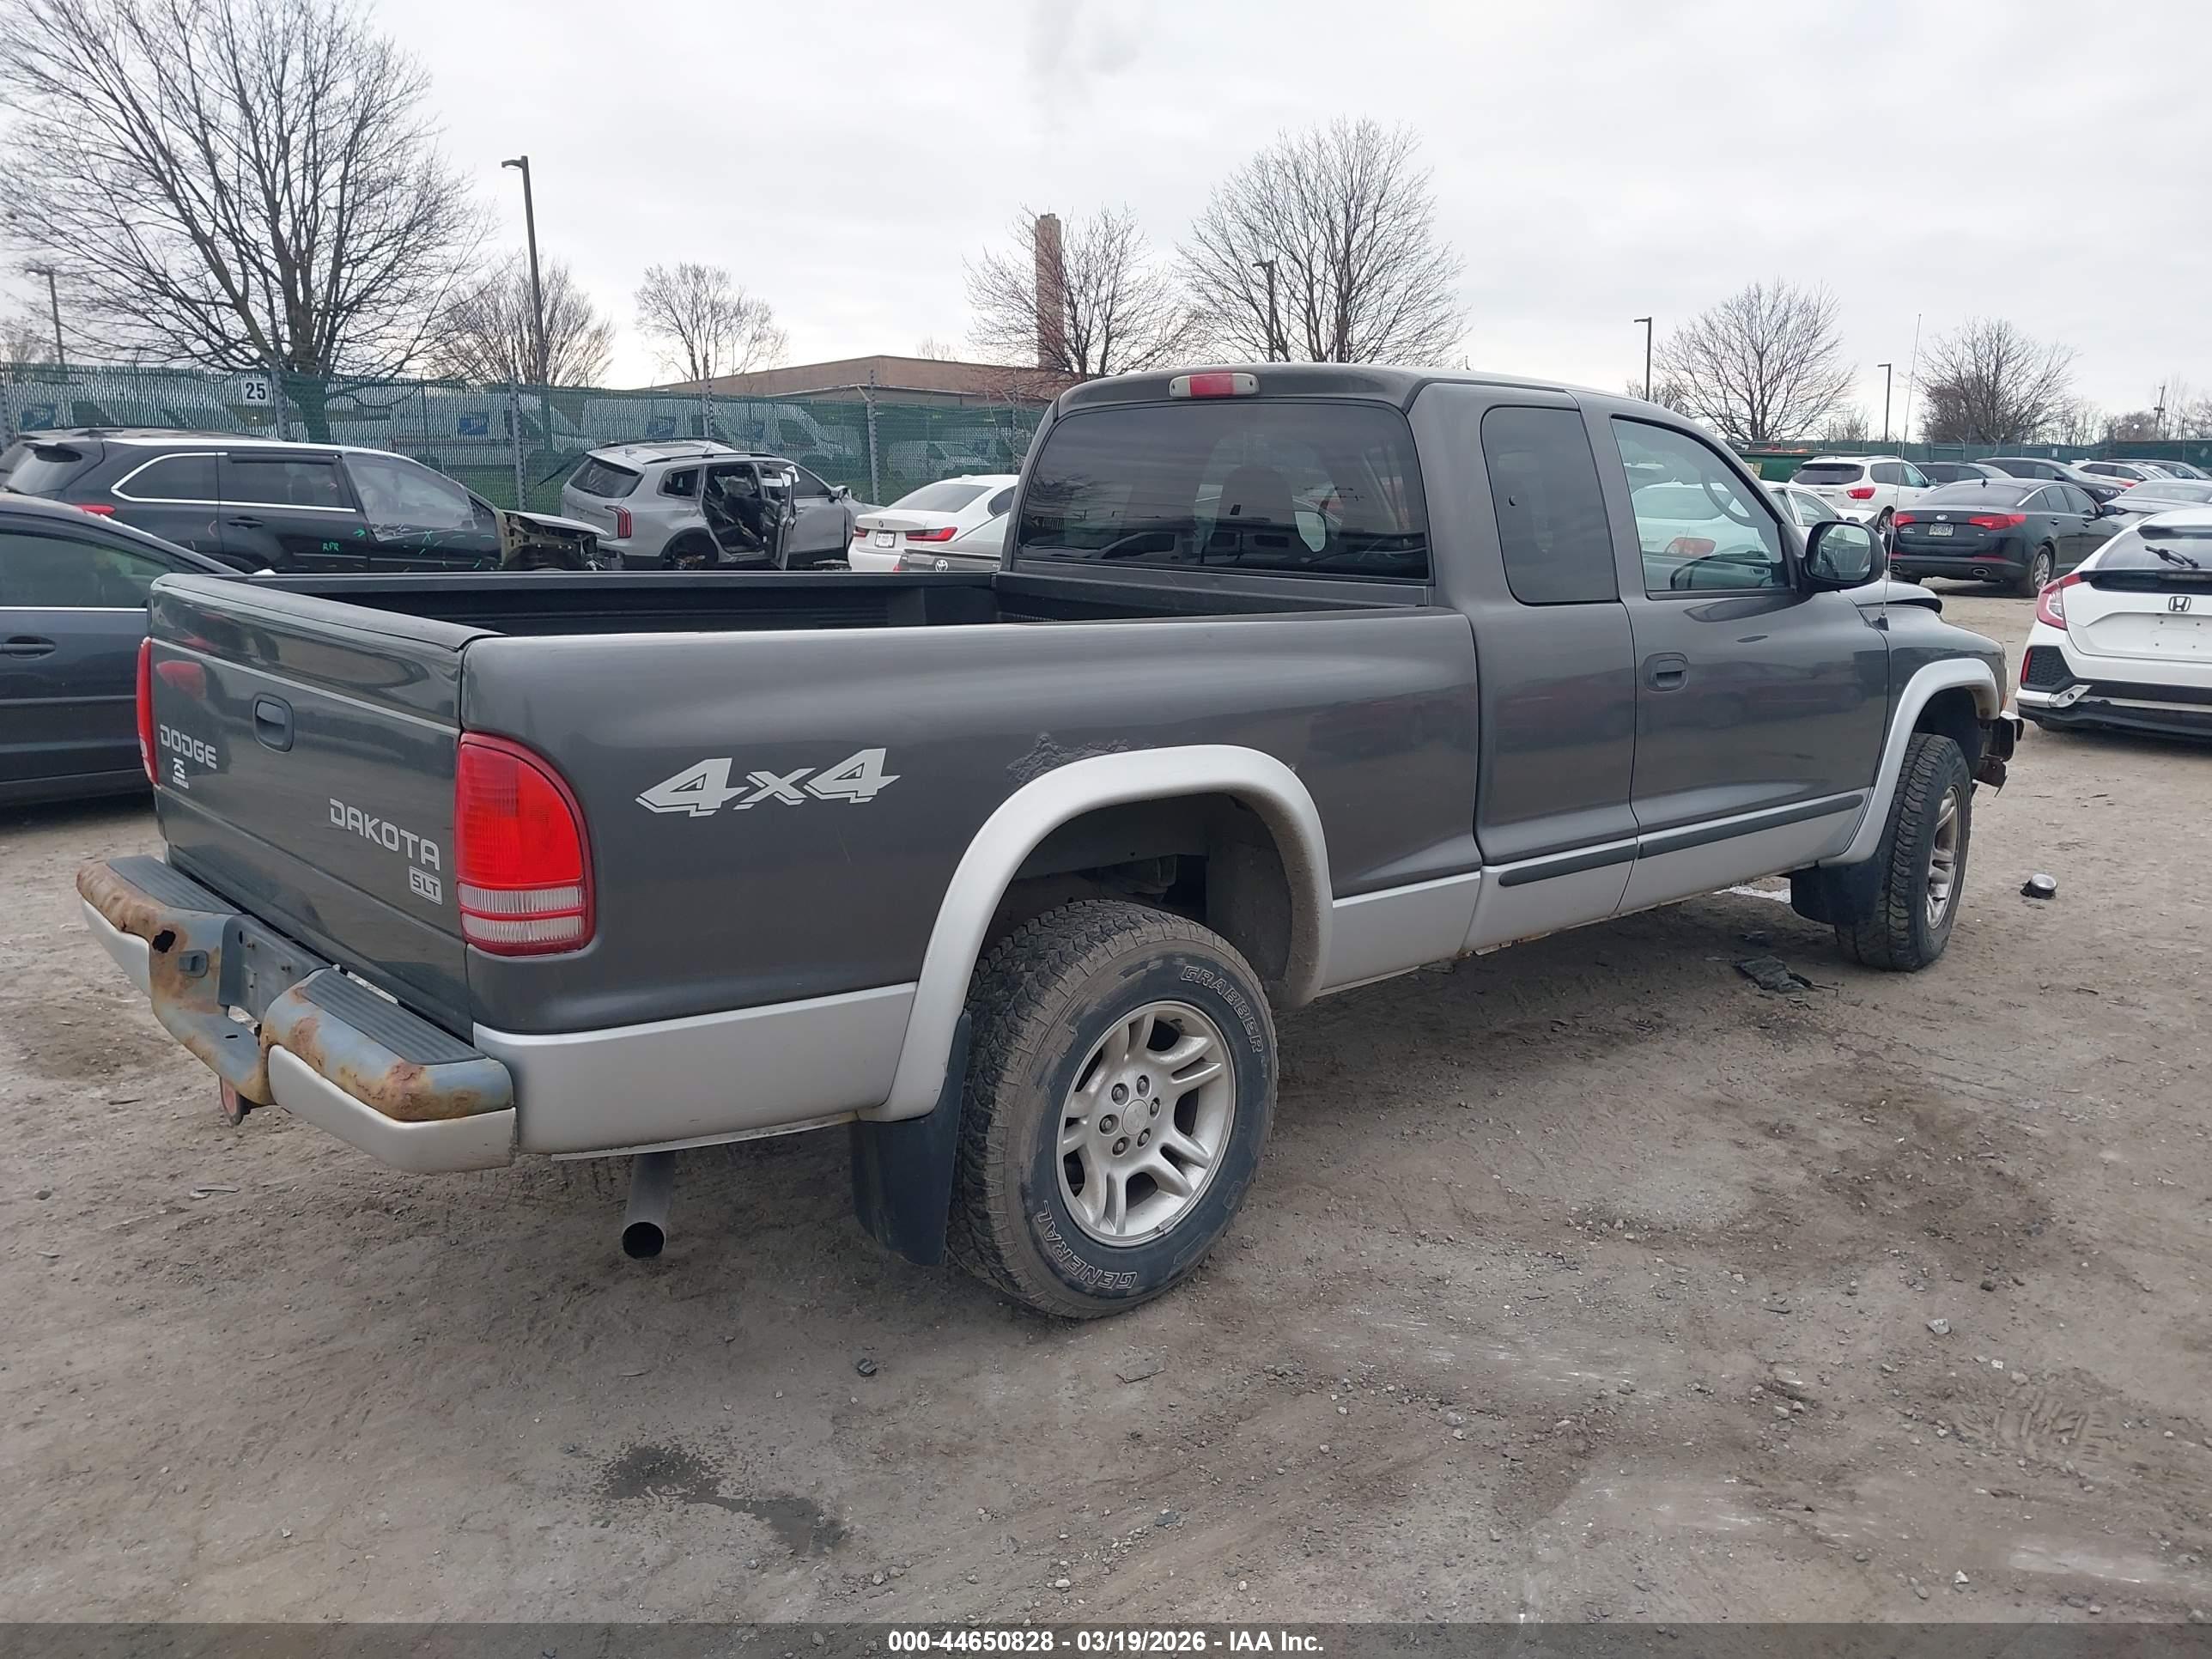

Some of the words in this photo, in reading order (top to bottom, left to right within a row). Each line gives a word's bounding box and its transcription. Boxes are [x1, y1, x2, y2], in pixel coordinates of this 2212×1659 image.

[246, 382, 266, 400] 25
[160, 724, 218, 770] DODGE
[330, 798, 441, 871] DAKOTA
[412, 873, 439, 897] SLT
[1181, 965, 1264, 1053] GRABBER
[1036, 1200, 1138, 1289] GENERAL
